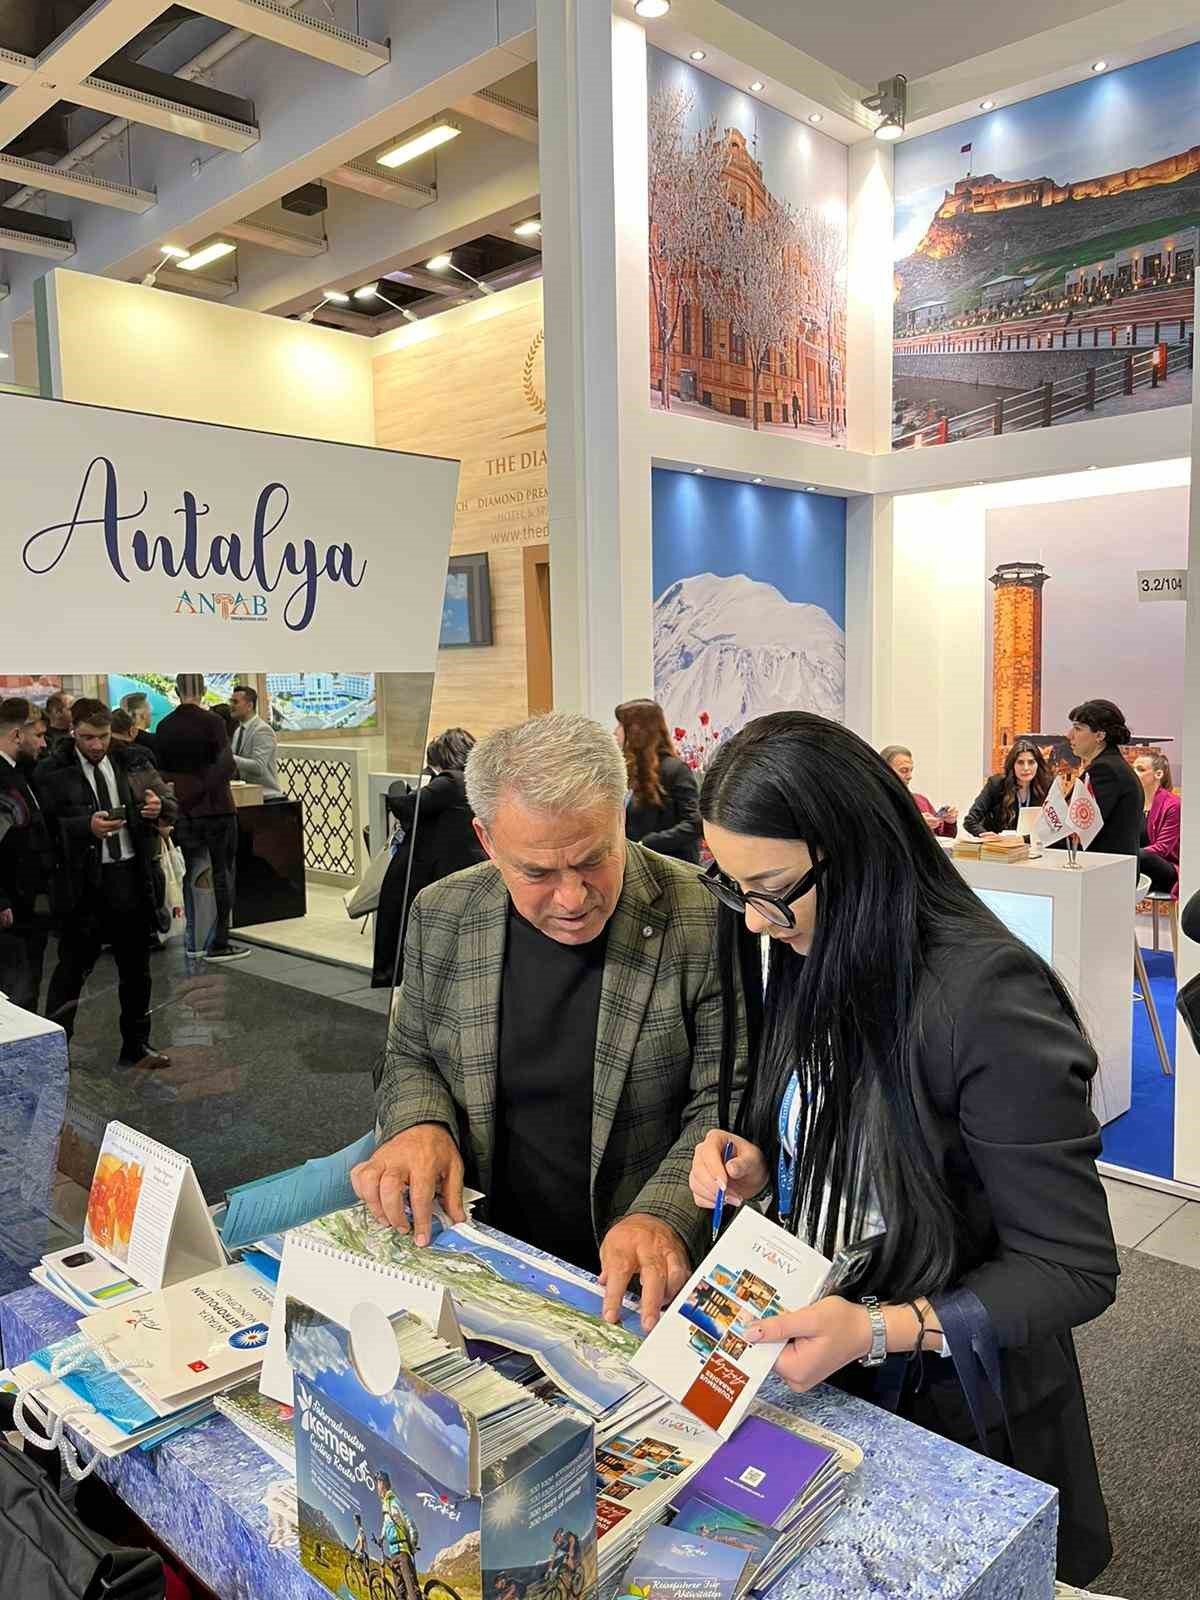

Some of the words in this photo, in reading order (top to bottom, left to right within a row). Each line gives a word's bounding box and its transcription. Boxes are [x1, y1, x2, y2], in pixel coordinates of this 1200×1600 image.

[486, 455, 516, 476] THE
[478, 490, 524, 509] DIAMOND
[23, 456, 367, 632] Antalya
[1141, 577, 1182, 592] 3.2/104
[191, 1286, 242, 1329] METROPOLITAN
